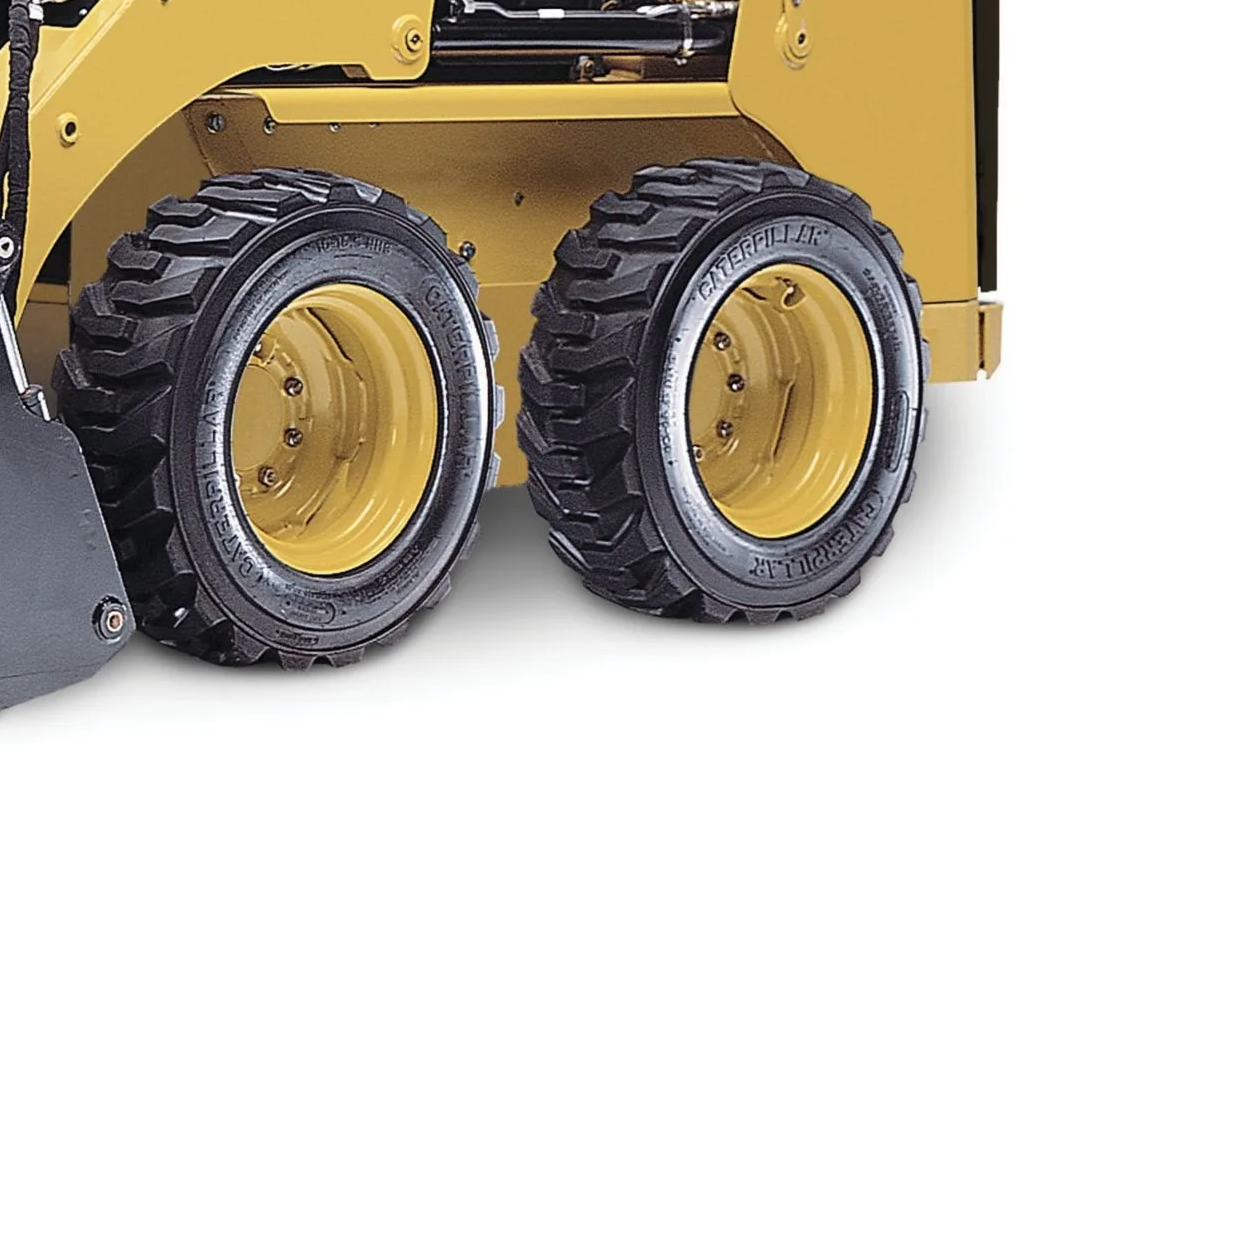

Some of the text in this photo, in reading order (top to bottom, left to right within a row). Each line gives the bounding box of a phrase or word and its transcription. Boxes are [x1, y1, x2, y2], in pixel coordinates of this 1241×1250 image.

[697, 223, 822, 301] CATERPILLAR
[202, 379, 255, 579] CATERPILLAR
[752, 501, 876, 579] CATERPILLAR
